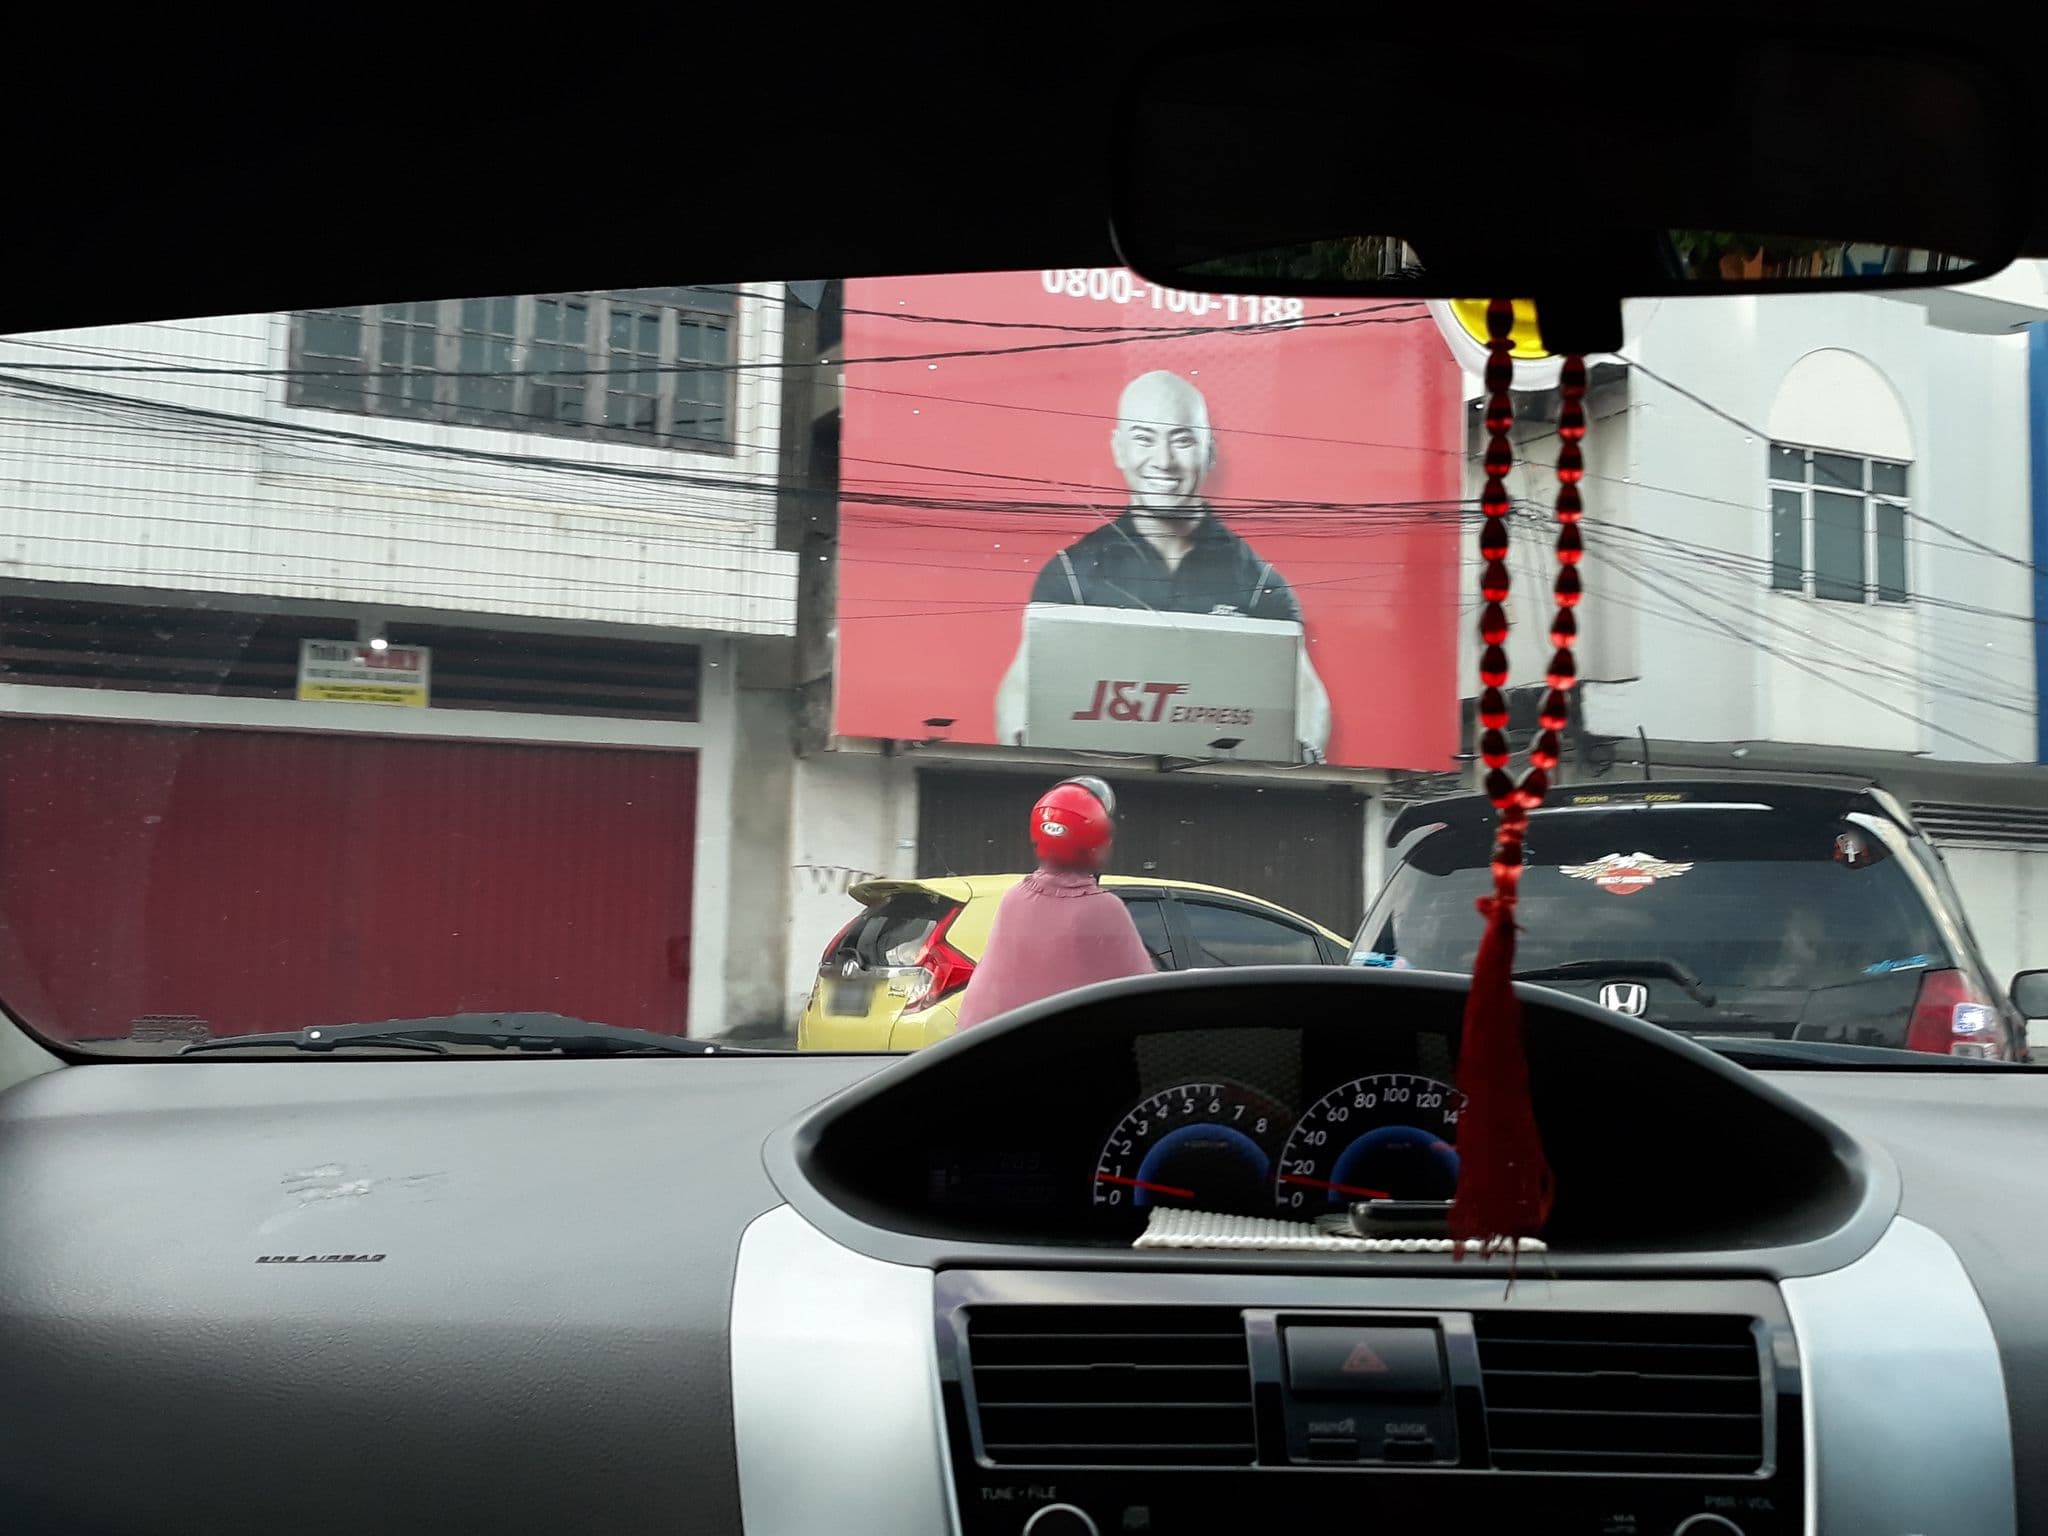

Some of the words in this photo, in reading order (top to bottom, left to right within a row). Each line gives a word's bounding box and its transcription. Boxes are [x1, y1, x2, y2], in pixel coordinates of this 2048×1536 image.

[1041, 269, 1305, 326] 0800-100-1188
[1071, 680, 1191, 722] J&T
[1169, 705, 1254, 726] EXPRESS
[1353, 1092, 1377, 1109] 80
[1383, 1087, 1410, 1103] 100
[1416, 1093, 1443, 1109] 120
[1326, 1106, 1349, 1123] 60
[1442, 1108, 1460, 1124] 14
[1303, 1130, 1327, 1147] 40
[1108, 1190, 1122, 1206] 0
[1120, 1141, 1133, 1156] 2
[1135, 1119, 1149, 1136] 3
[1155, 1104, 1169, 1120] 4
[1182, 1098, 1195, 1114] 5
[1208, 1097, 1221, 1113] 6
[1234, 1105, 1246, 1121] 7
[1255, 1118, 1270, 1134] 8
[1293, 1159, 1315, 1175] 20
[1290, 1192, 1304, 1207] 0
[302, 1254, 387, 1263] AIRBAG
[980, 1487, 1015, 1500] TUNE
[1027, 1485, 1056, 1499] FILE
